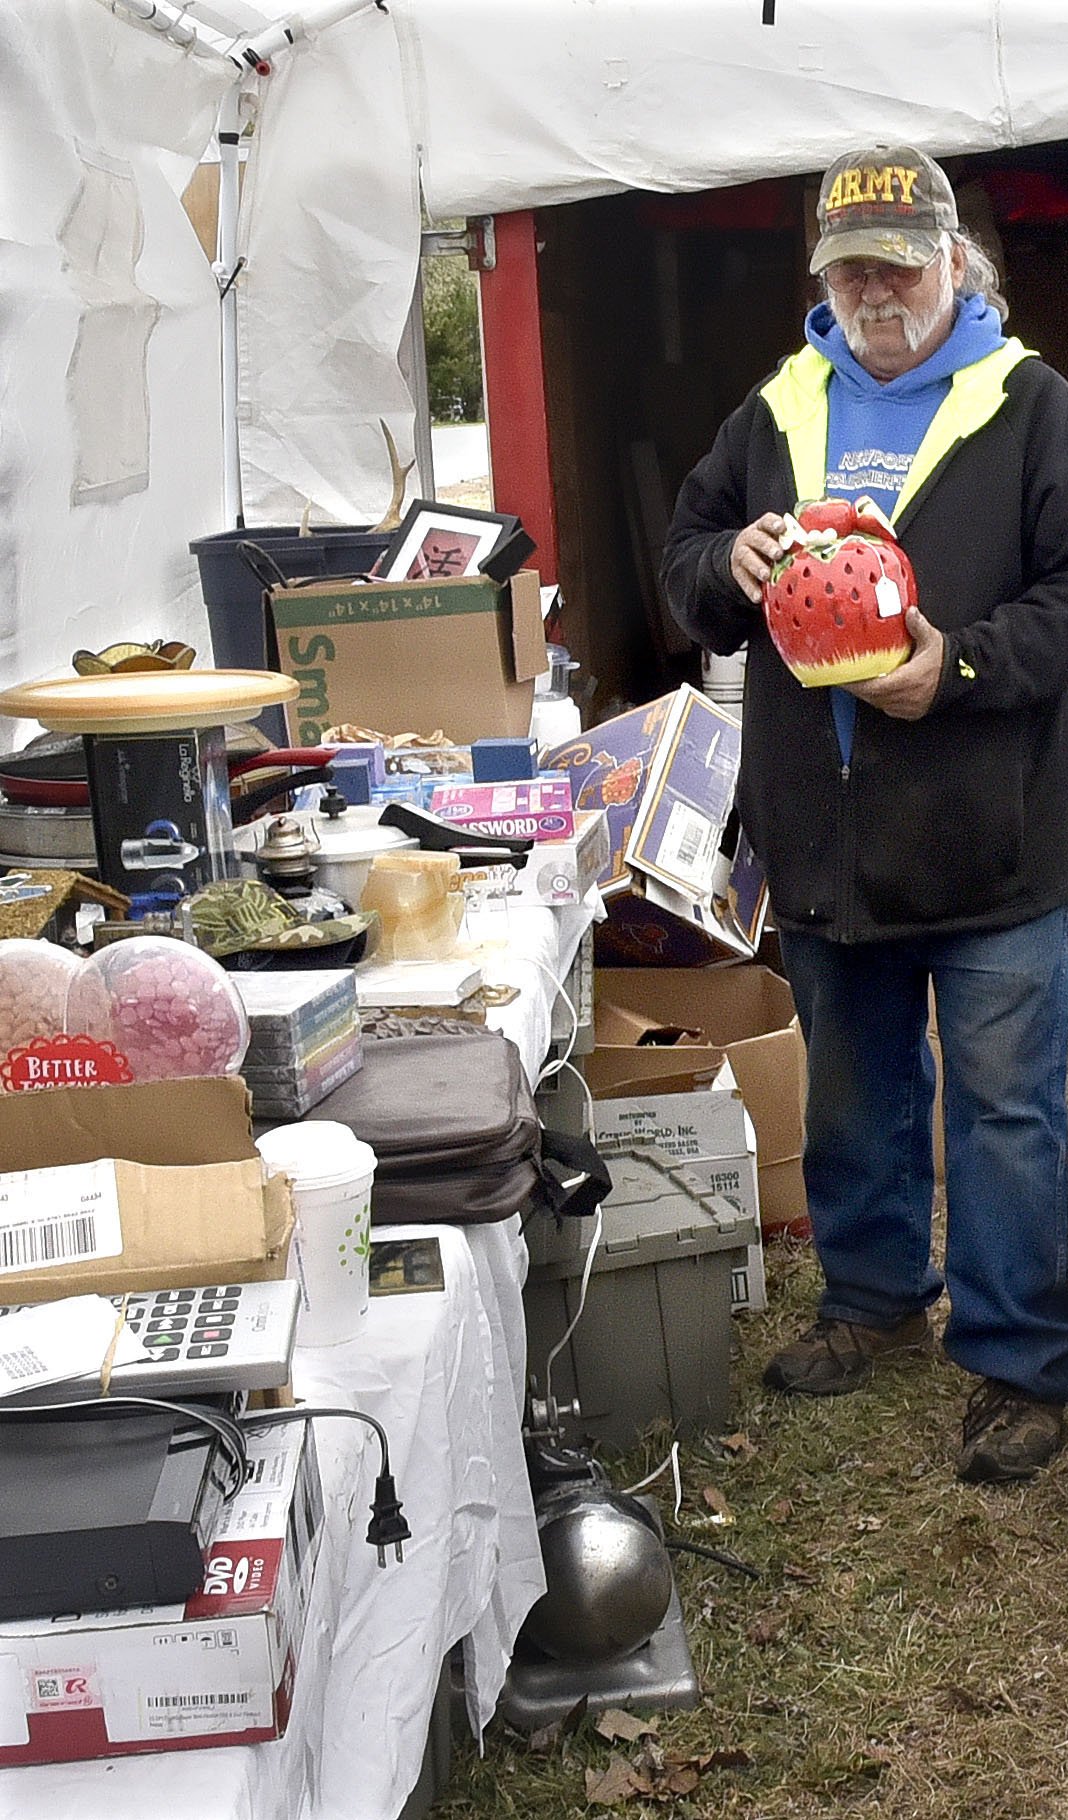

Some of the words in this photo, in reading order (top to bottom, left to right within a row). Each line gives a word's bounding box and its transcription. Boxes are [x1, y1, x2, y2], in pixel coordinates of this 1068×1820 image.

[825, 166, 917, 211] ARMY
[25, 1057, 97, 1079] BETTER
[203, 1557, 233, 1595] DVD
[250, 1558, 264, 1590] VIDEO
